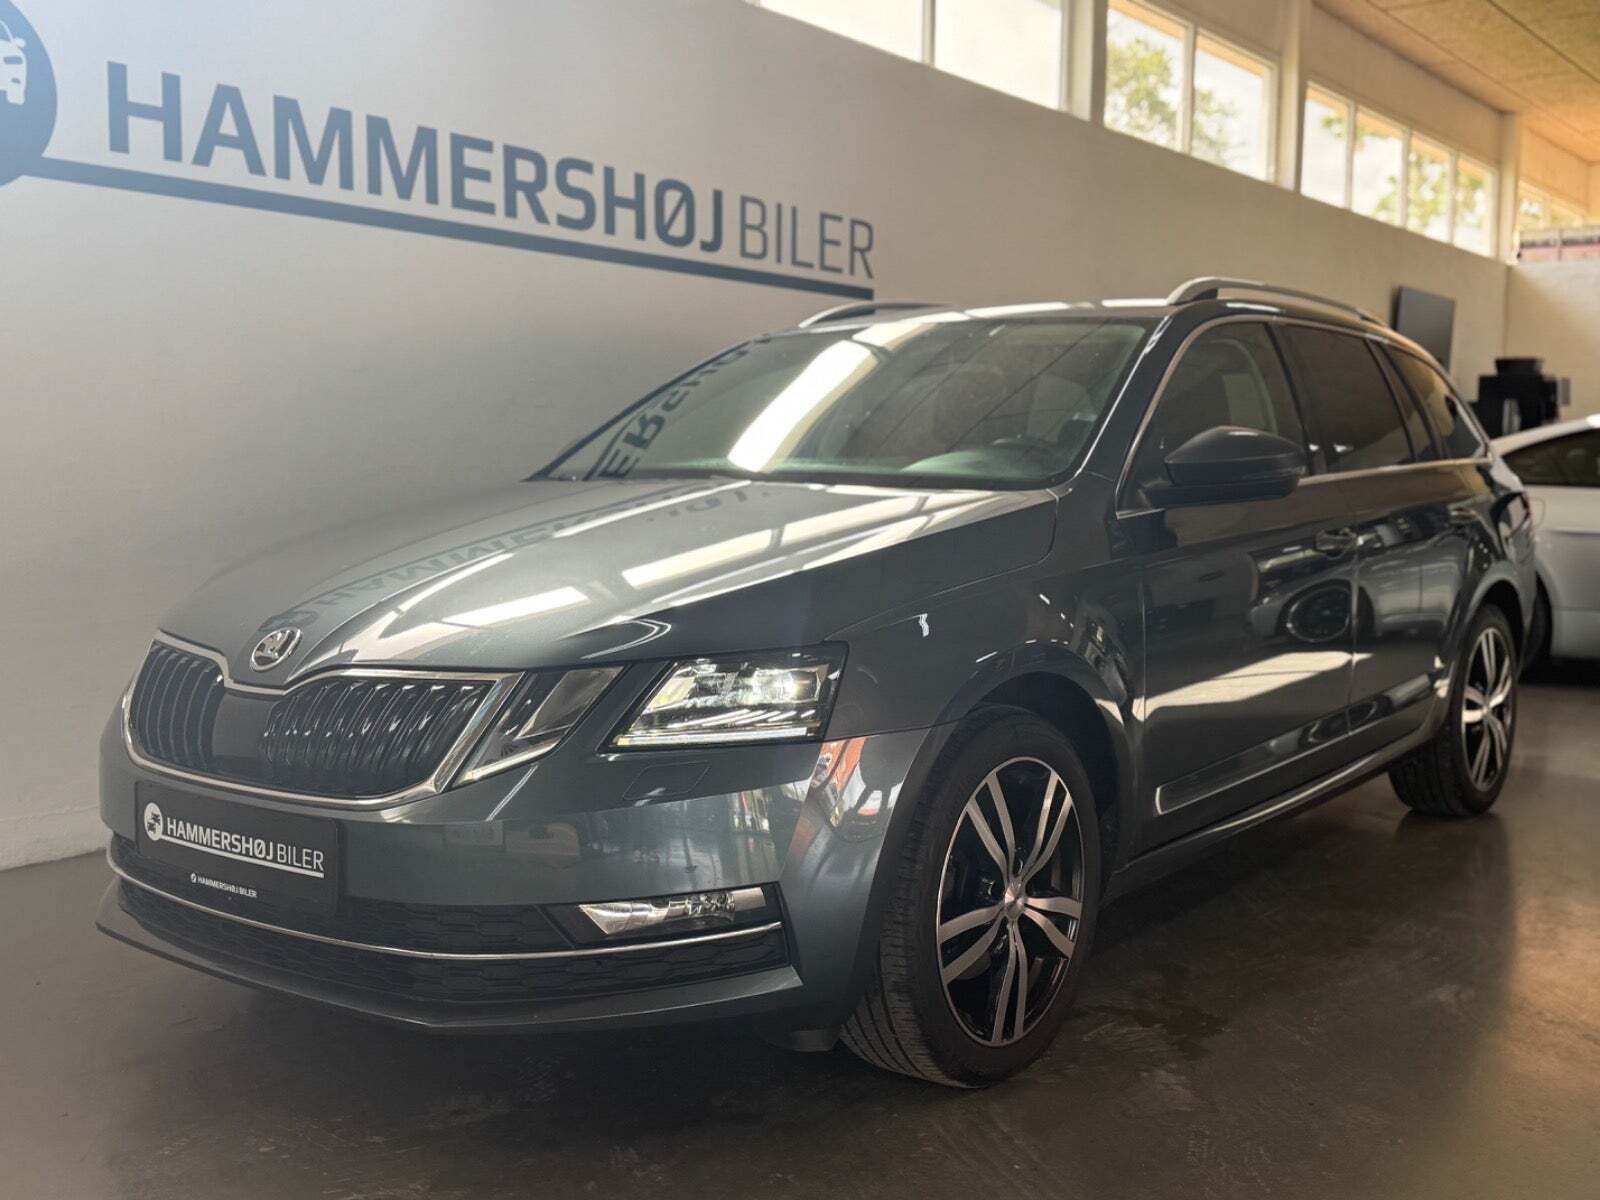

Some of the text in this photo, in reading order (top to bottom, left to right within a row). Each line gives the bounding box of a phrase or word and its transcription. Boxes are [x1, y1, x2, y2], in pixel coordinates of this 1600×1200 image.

[106, 60, 875, 280] HAMMERSHØJ BILER
[167, 817, 325, 871] HAMMERSHØJ BILER
